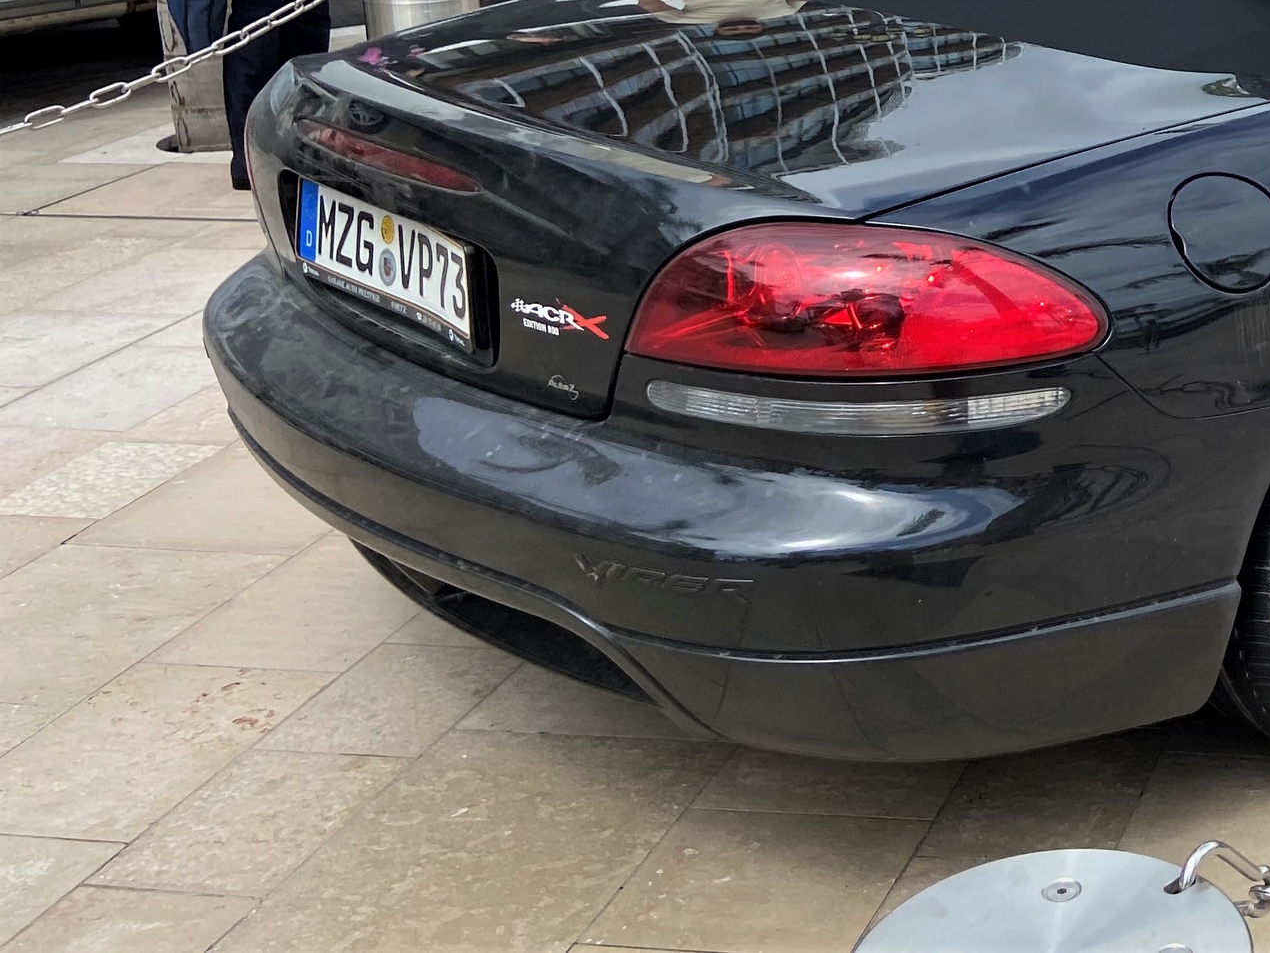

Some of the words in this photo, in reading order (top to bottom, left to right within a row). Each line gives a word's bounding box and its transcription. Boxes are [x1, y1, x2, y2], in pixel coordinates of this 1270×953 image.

[306, 229, 314, 247] D
[318, 194, 375, 277] MZG
[523, 317, 548, 334] EDITION
[574, 553, 754, 604] VIPER
